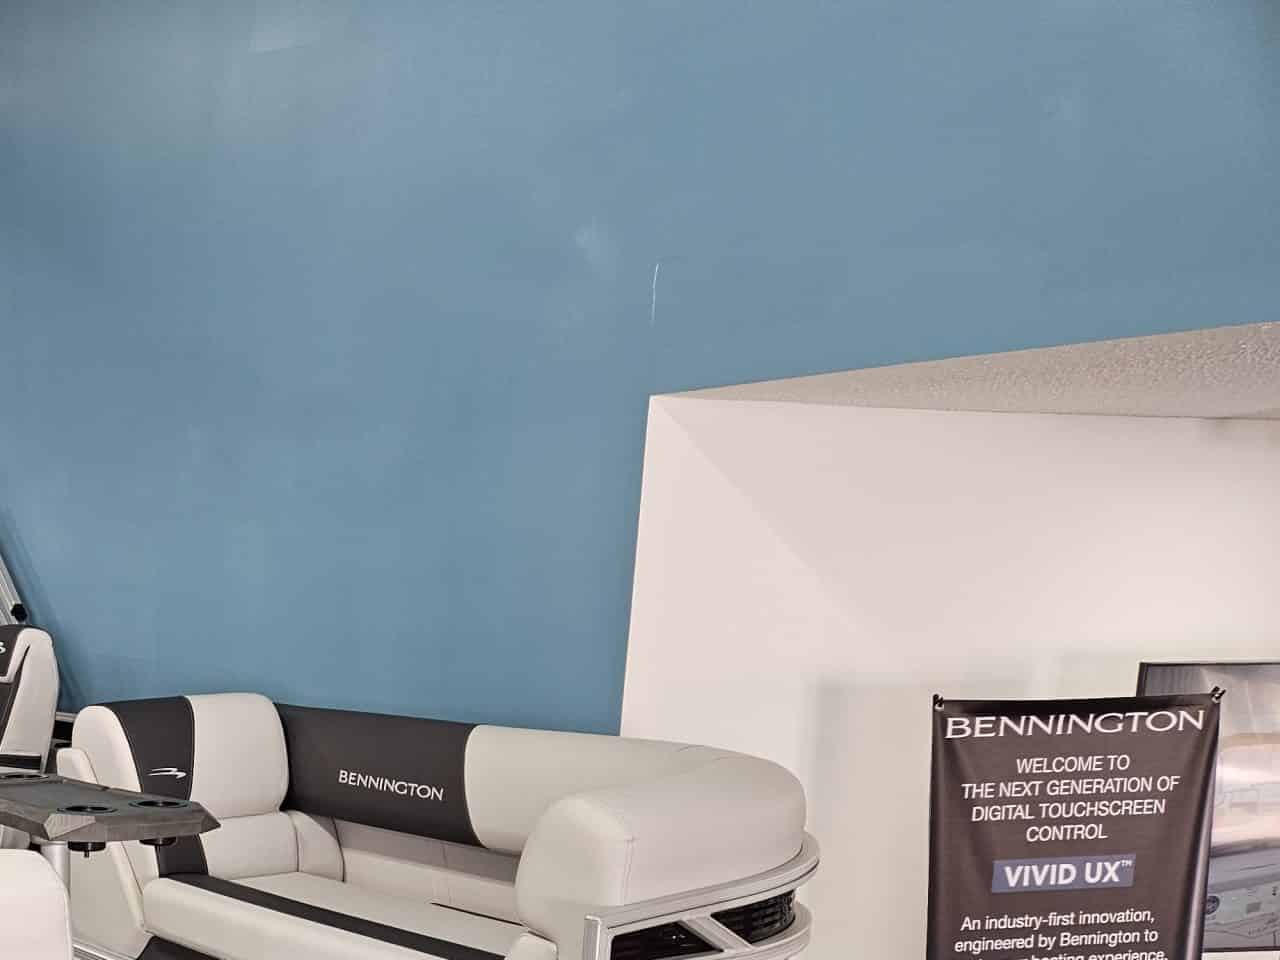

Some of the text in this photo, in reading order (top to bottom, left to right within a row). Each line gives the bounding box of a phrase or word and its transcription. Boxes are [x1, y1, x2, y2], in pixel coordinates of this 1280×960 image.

[945, 709, 1205, 739] BENNINGTON
[1016, 754, 1130, 774] WELCOME TO
[338, 769, 444, 801] BENNINGTON
[961, 775, 1181, 800] THE NEXT GENERATION OF
[971, 799, 1166, 822] DIGITAL TOUCHSCREEN
[1026, 824, 1108, 842] CONTROL
[1004, 863, 1077, 888] VIVID
[960, 908, 1155, 932] An industry-first innovation,
[954, 928, 1159, 955] engineered by Bennington to
